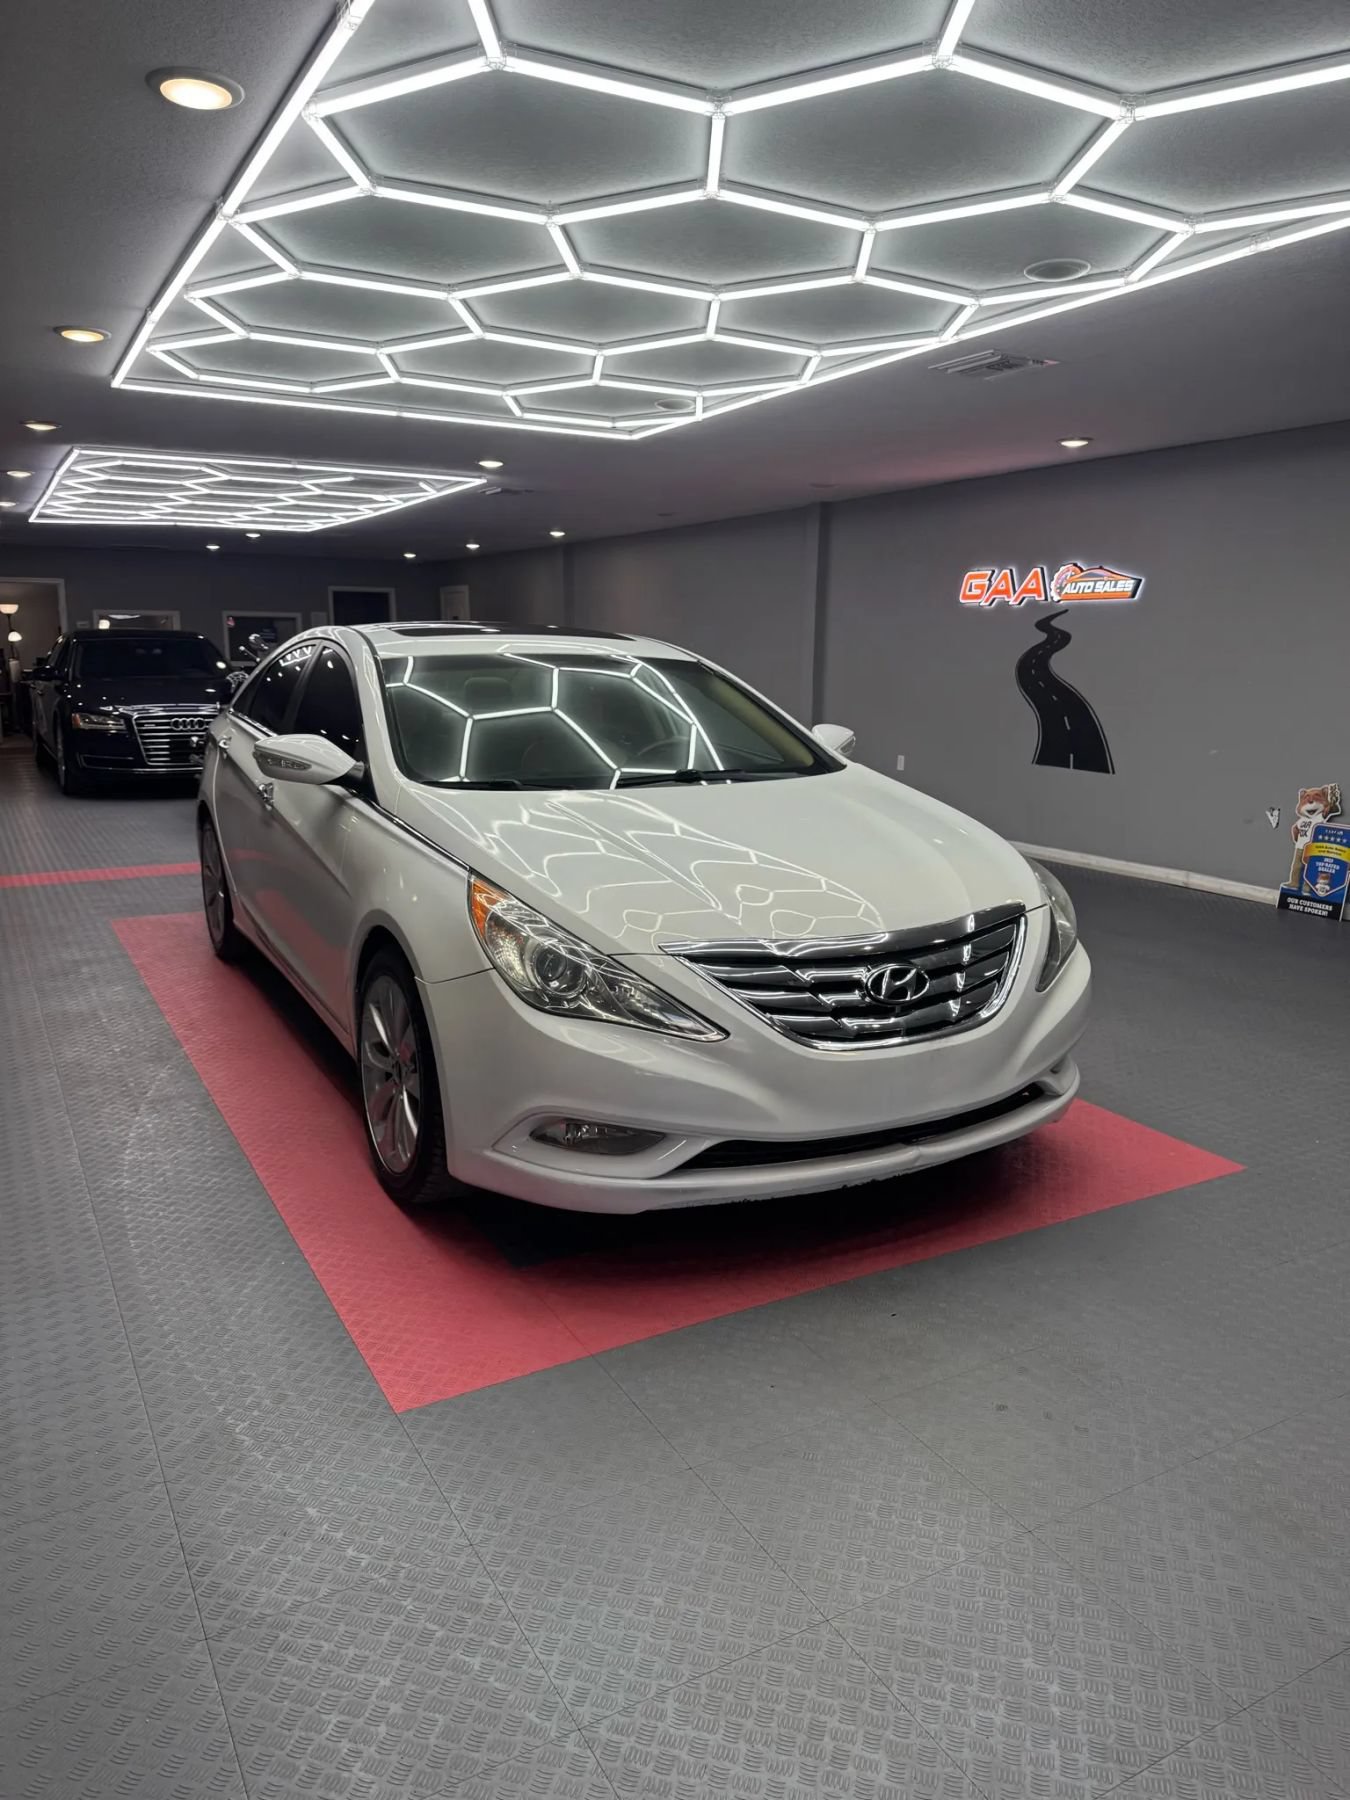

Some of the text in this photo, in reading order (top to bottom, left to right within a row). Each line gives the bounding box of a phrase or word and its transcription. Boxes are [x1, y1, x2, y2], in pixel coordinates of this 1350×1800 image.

[959, 566, 1048, 607] GAA
[1062, 580, 1135, 594] AUTO SALES
[1286, 897, 1332, 911] OUR CUSTOMERS
[1289, 903, 1304, 912] HAVE
